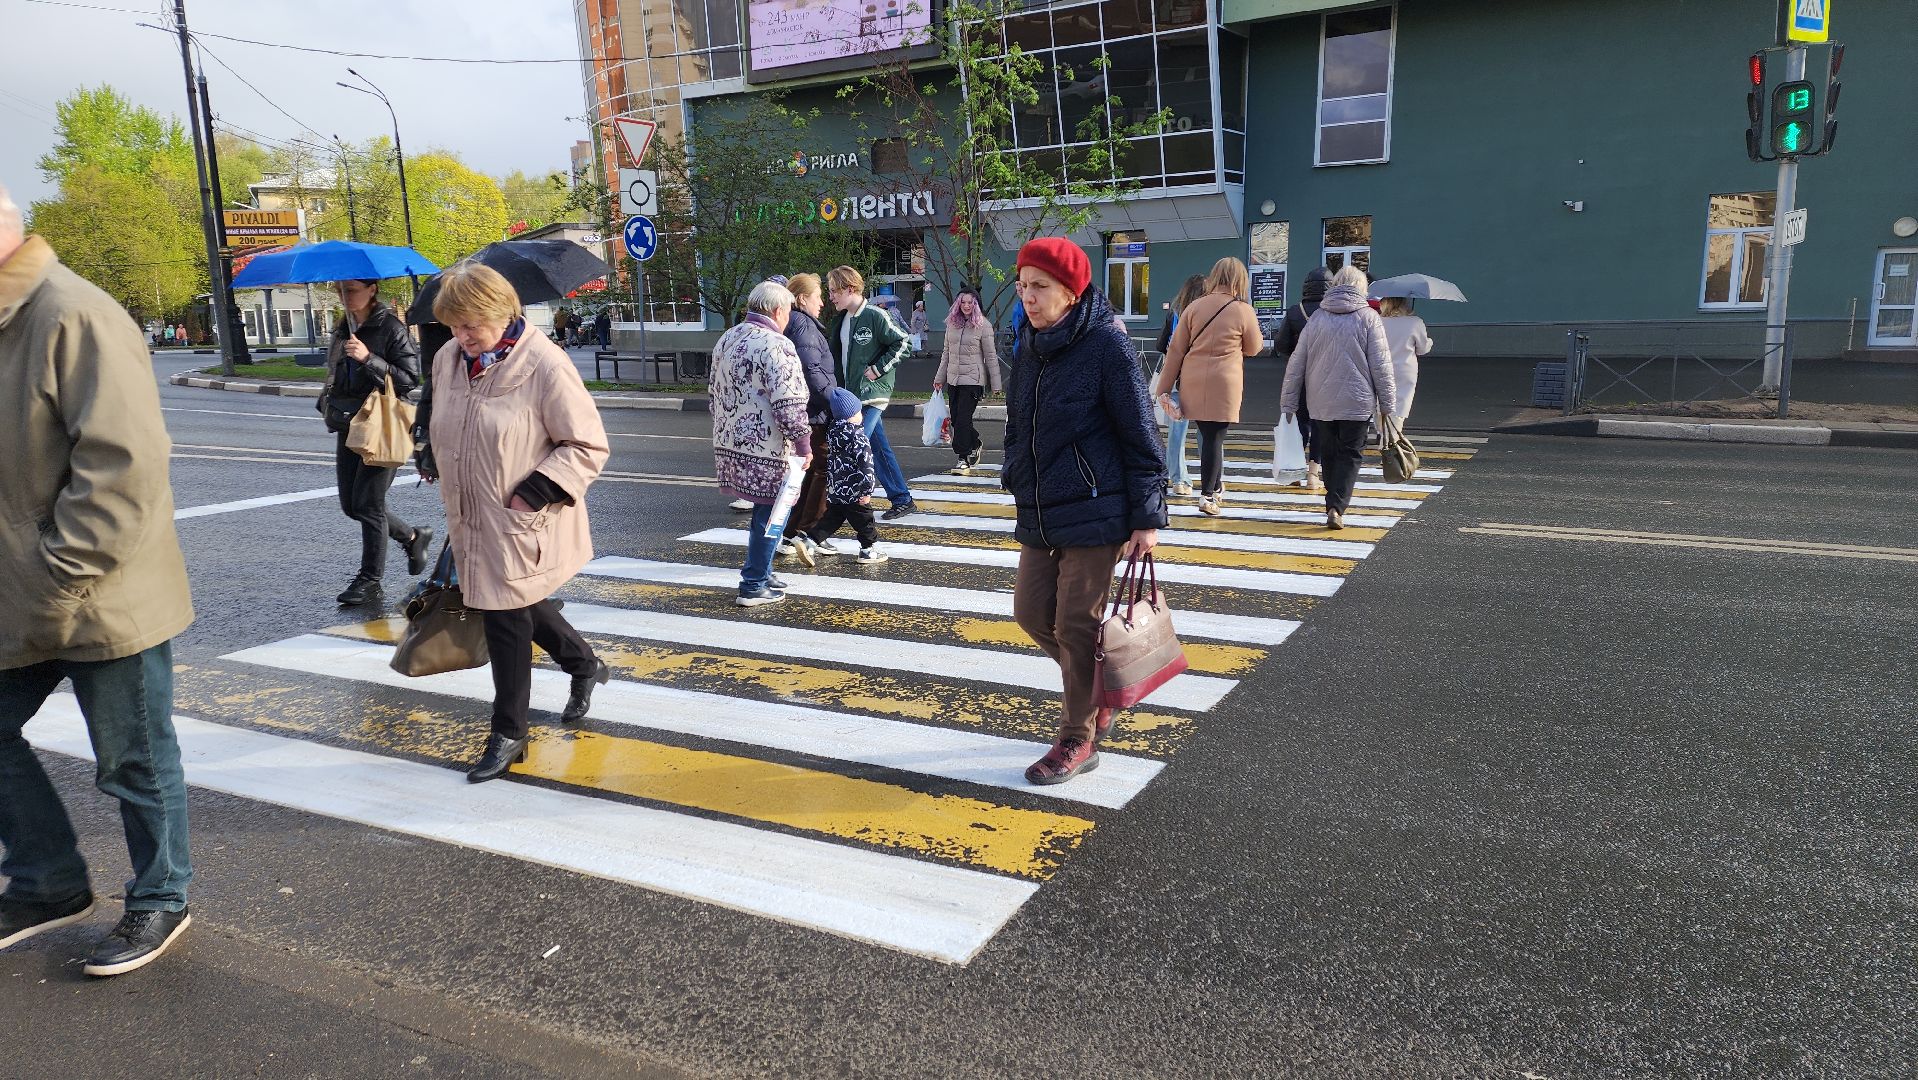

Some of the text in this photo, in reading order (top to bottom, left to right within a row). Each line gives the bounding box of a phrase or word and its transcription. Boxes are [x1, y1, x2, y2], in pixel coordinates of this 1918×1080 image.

[767, 10, 788, 26] 243
[1790, 90, 1809, 110] 13
[811, 152, 859, 170] РИГЛА
[232, 213, 280, 224] PIVALDI
